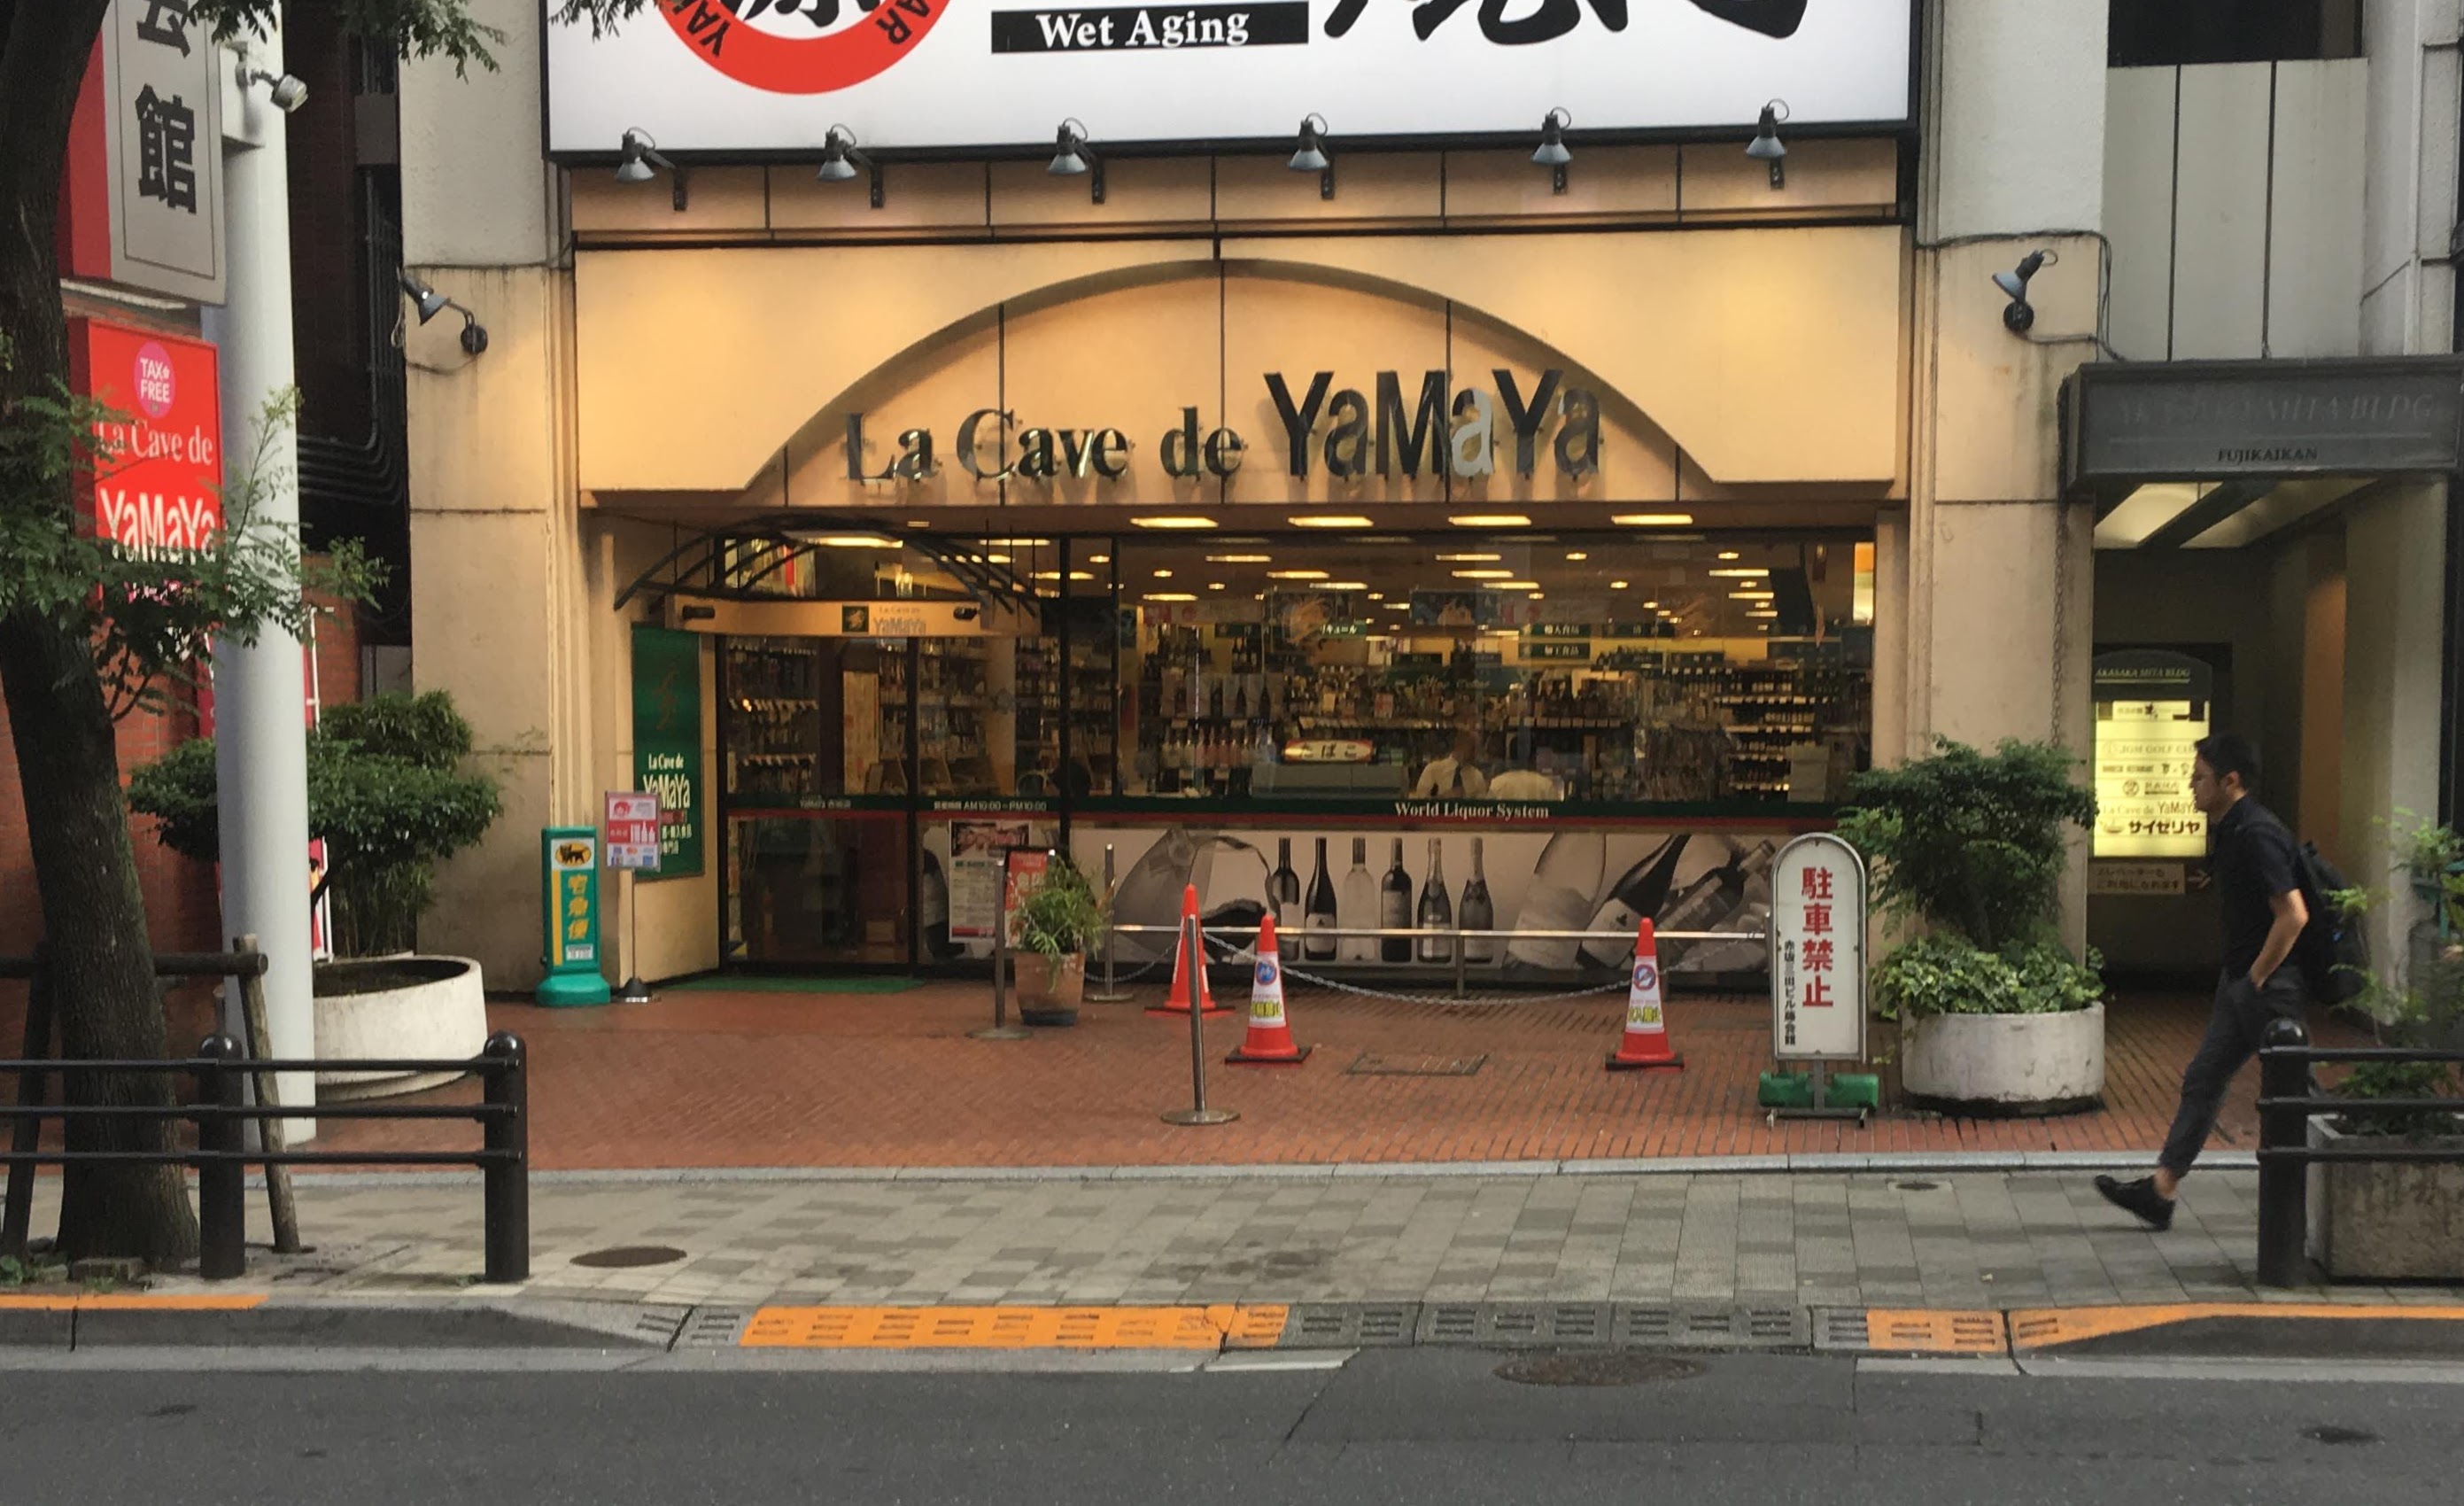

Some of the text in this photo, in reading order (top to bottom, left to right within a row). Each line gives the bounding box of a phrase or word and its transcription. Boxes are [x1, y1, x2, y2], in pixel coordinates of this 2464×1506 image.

[1034, 10, 1251, 49] Wet Aging
[139, 357, 163, 380] TAX
[140, 379, 171, 403] FREE
[843, 369, 1601, 483] La Cave de YaMaYa
[97, 419, 213, 466] La Cave de
[2217, 447, 2319, 465] FUJIKAIKAN
[99, 487, 217, 566] YaMaYa
[647, 753, 657, 771] La
[1394, 802, 1550, 822] World Liquor System
[1801, 866, 1834, 1008] 駐車禁止
